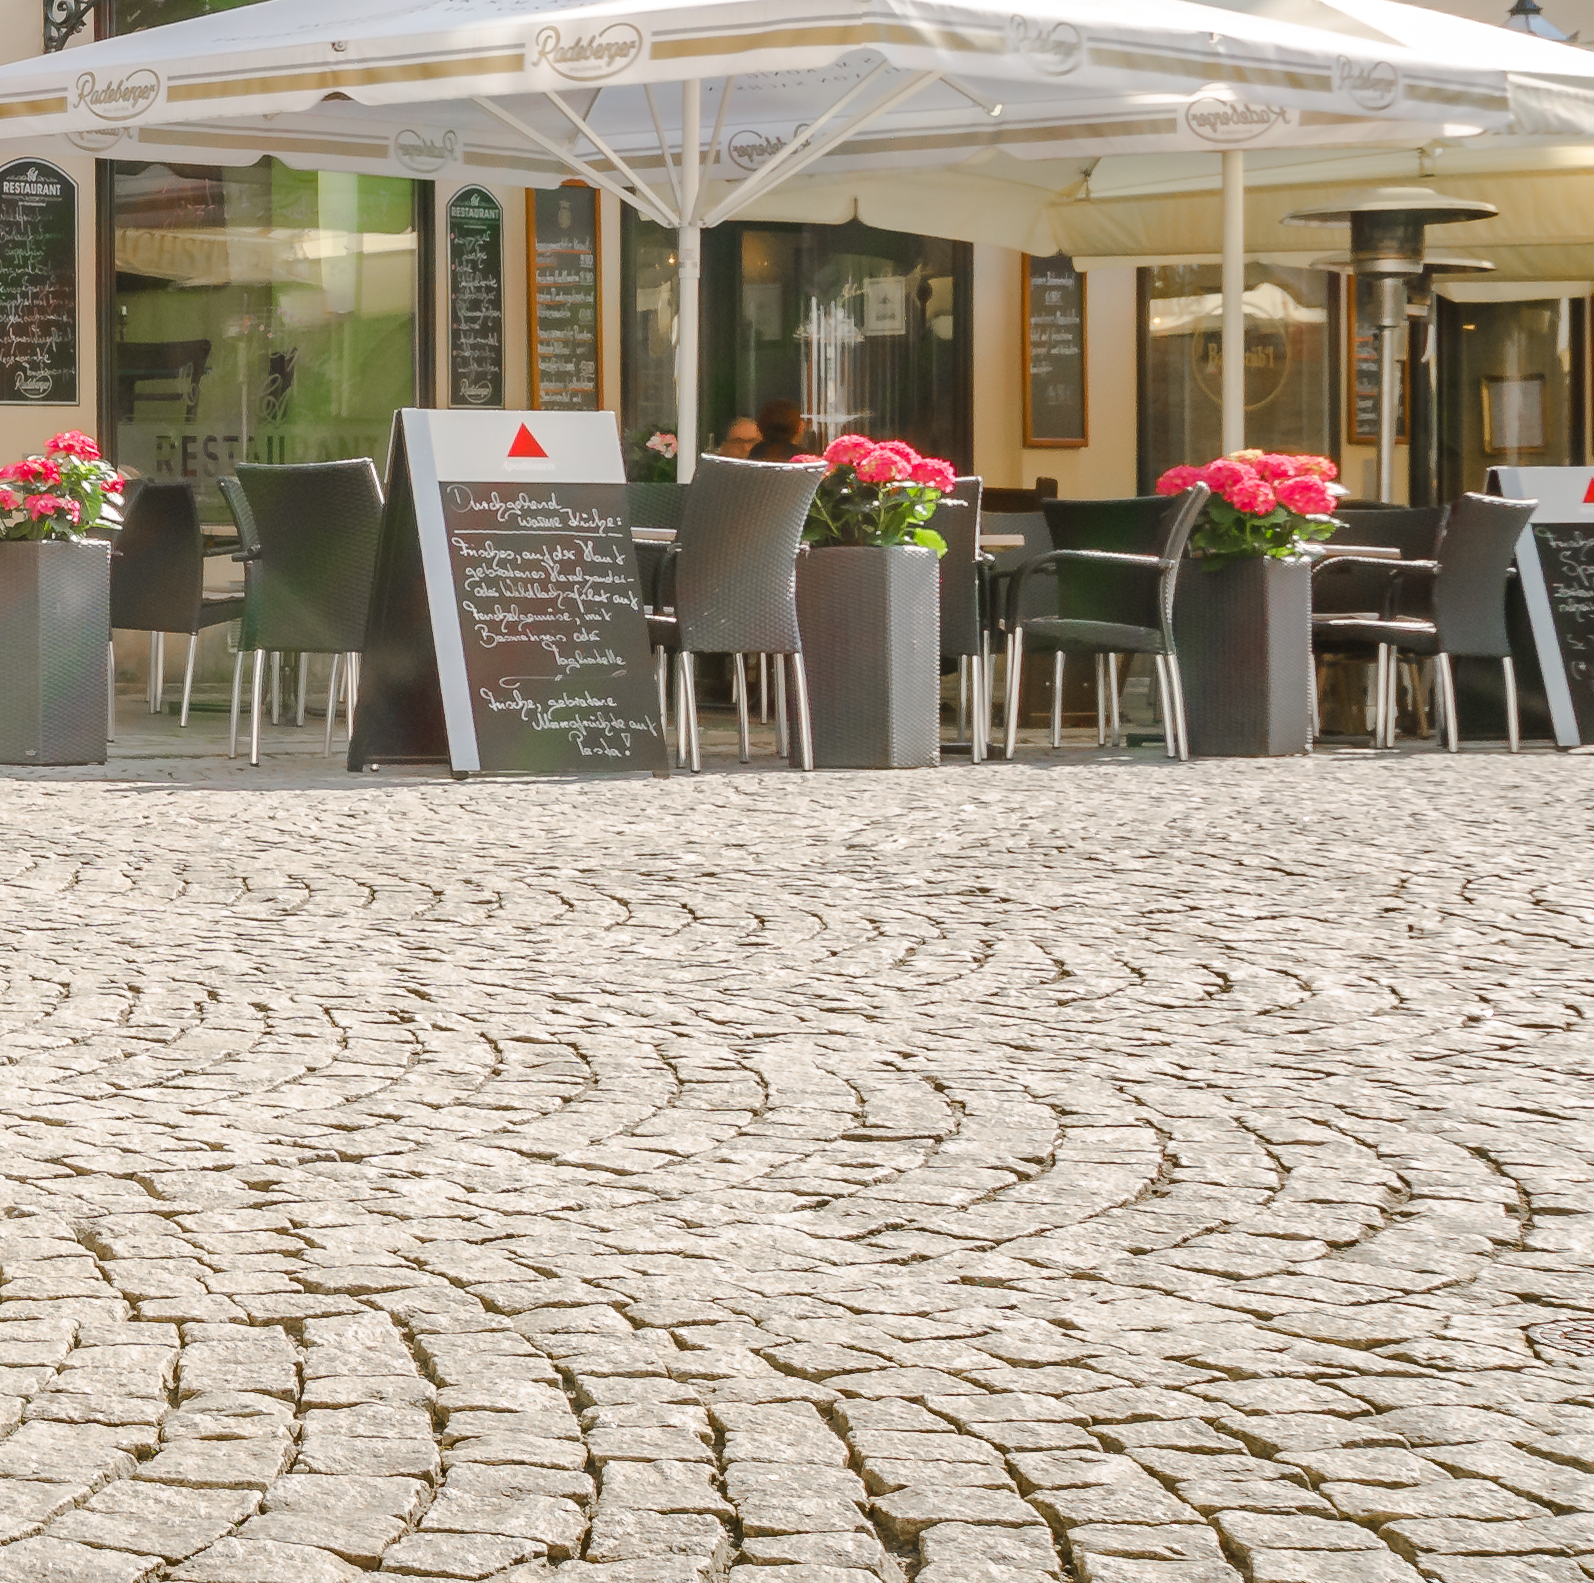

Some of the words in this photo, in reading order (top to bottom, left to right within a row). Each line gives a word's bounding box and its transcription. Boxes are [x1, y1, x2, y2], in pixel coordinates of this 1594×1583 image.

[73, 69, 160, 115] Radeberger
[3, 182, 61, 196] RESTAURANT
[447, 484, 562, 522] Durchgehend
[518, 516, 563, 528] warme
